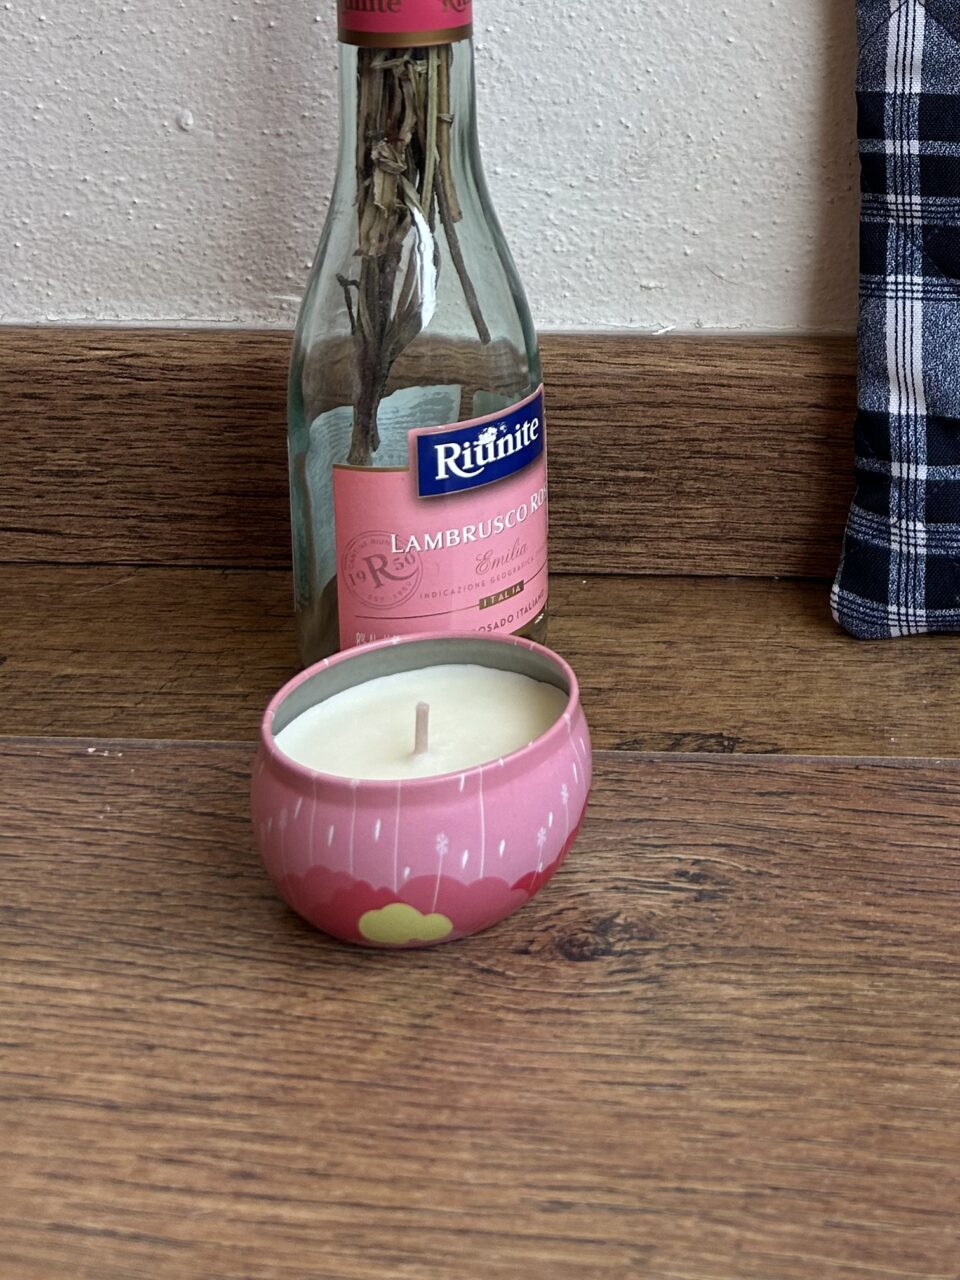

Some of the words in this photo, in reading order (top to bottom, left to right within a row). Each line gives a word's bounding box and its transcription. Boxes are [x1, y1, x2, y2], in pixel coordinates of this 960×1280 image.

[434, 417, 539, 481] Riunite
[390, 503, 528, 554] LAMBRUSCO
[475, 537, 528, 576] Emilia
[419, 581, 486, 600] INDICAZIONE
[483, 583, 521, 607] ITALIA
[473, 614, 514, 632] OSADO
